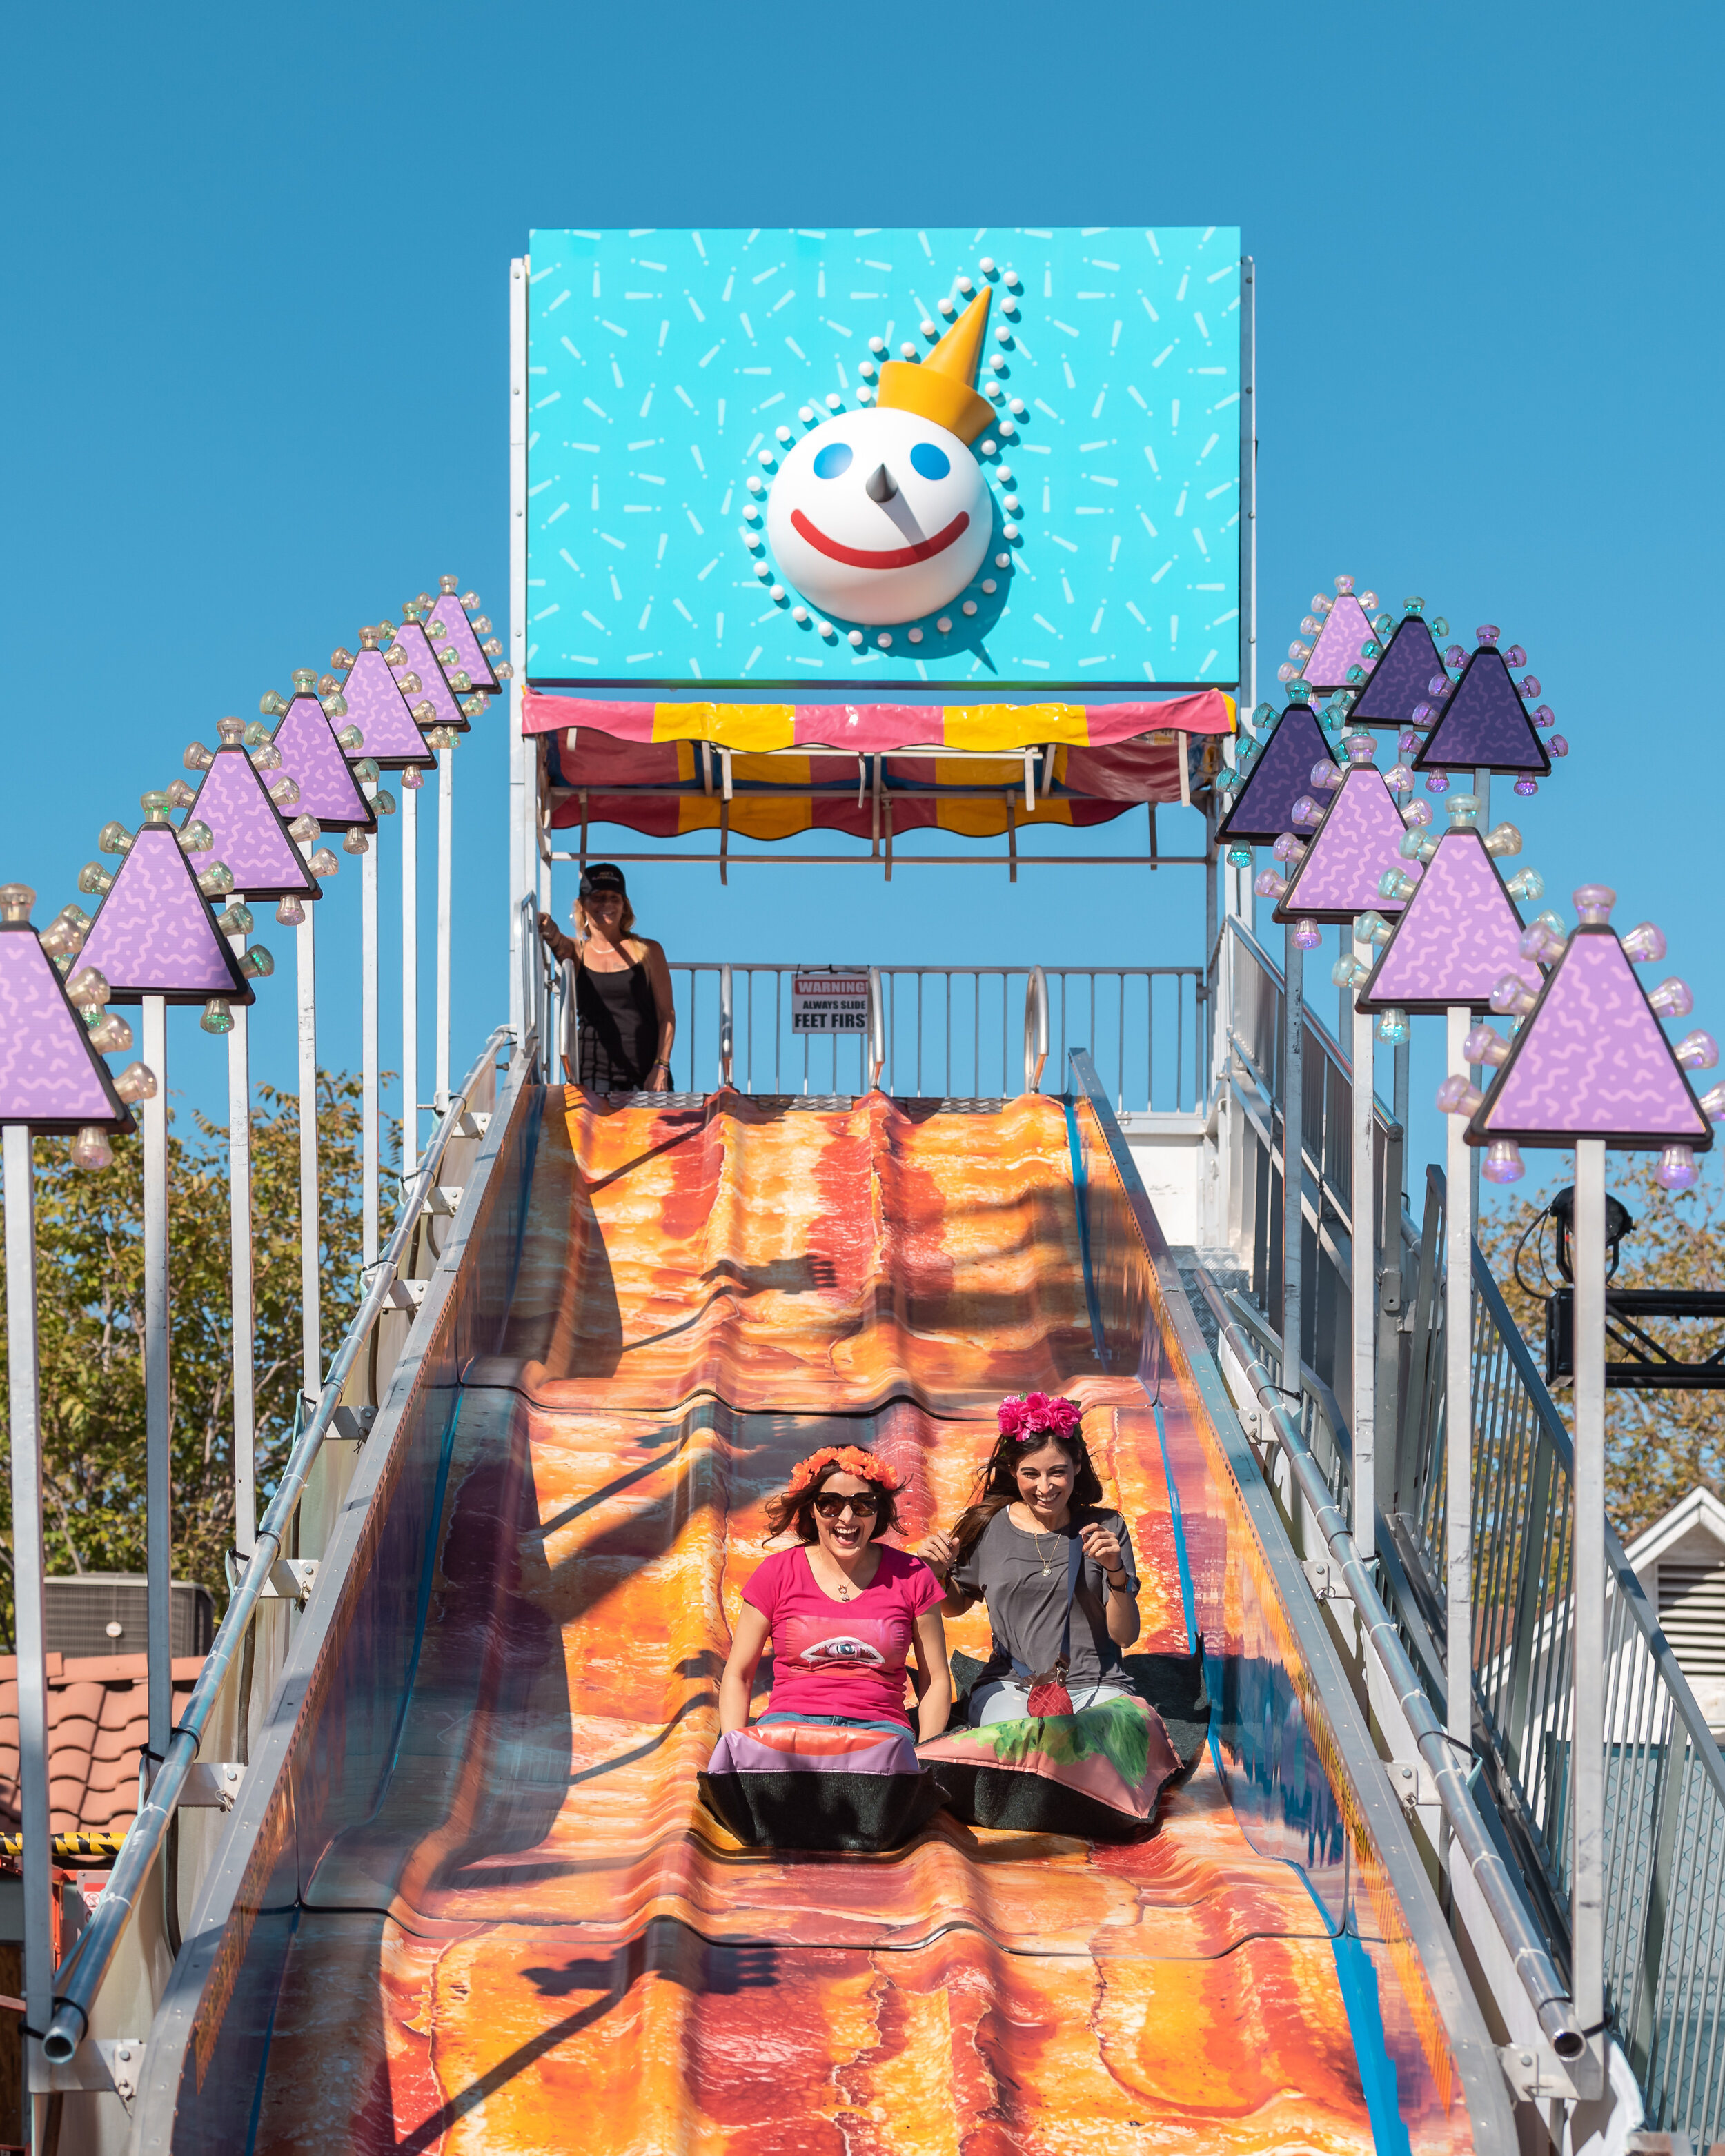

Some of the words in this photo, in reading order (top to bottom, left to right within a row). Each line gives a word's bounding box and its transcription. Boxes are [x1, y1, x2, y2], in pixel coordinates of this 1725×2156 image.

[803, 1000, 838, 1009] ALWAYS
[840, 1000, 865, 1009] SLIDE
[795, 1013, 827, 1027] FEET
[831, 1013, 868, 1027] FIRS
